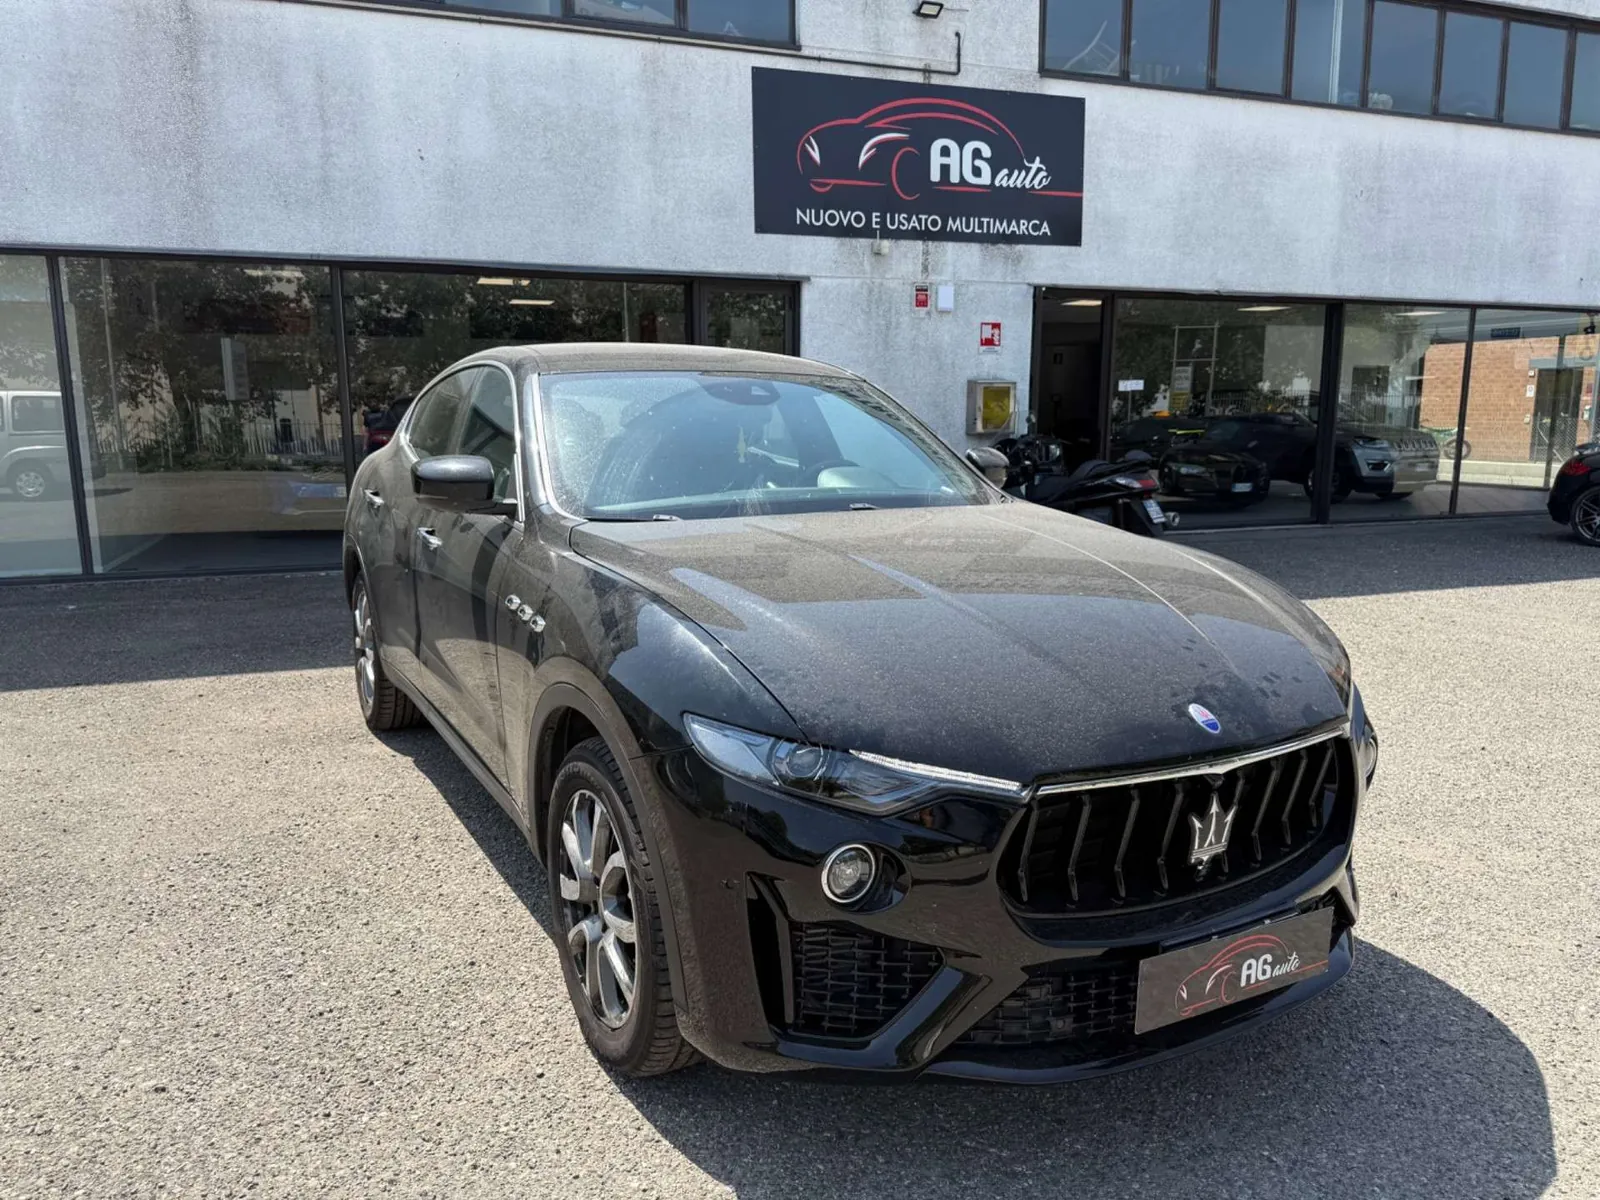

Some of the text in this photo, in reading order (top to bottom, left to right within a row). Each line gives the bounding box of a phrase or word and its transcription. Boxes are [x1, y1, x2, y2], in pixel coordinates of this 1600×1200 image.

[930, 138, 1052, 190] AG auto
[796, 208, 1051, 236] NUOVO E USATO MULTIMARCA
[1240, 952, 1300, 987] AG auto
